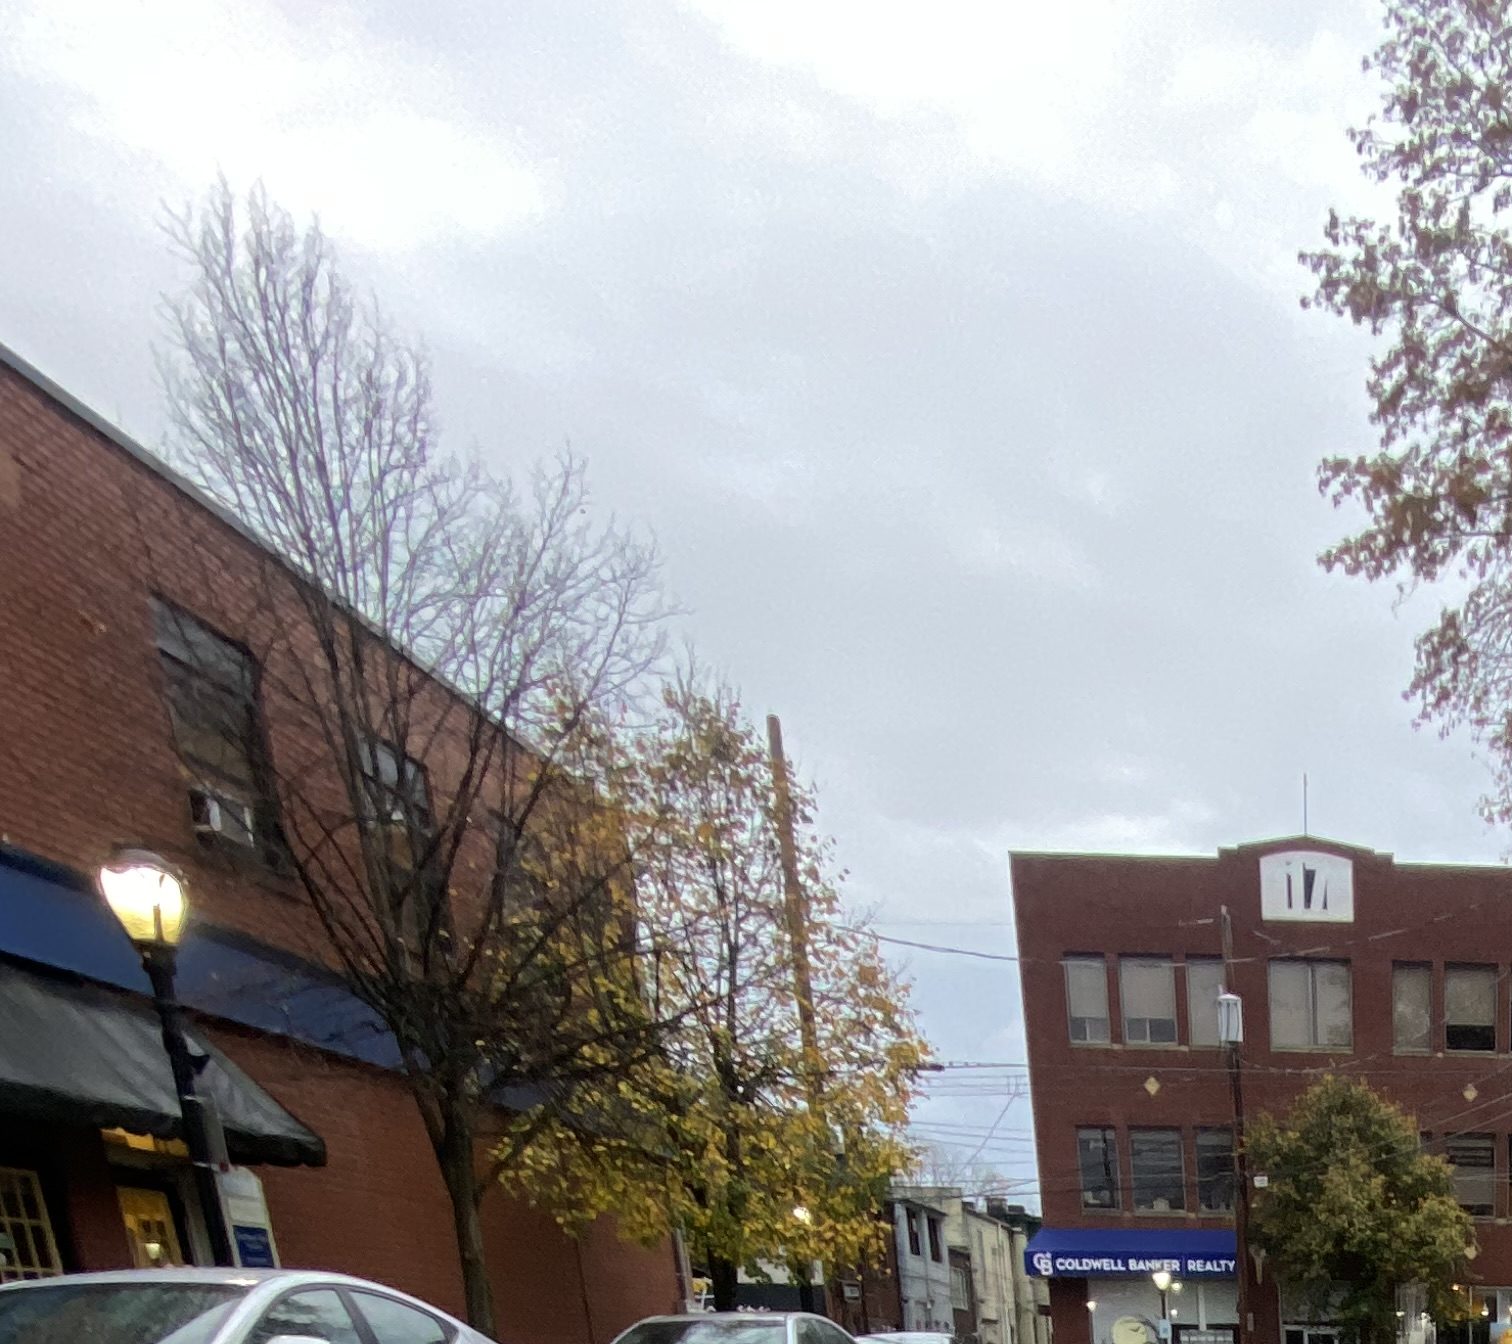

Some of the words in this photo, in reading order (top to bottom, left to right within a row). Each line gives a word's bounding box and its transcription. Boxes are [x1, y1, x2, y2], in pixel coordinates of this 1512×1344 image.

[1056, 1258, 1126, 1271] COLDWELL
[1128, 1258, 1180, 1272] BANKER
[1187, 1260, 1236, 1272] REALTY
